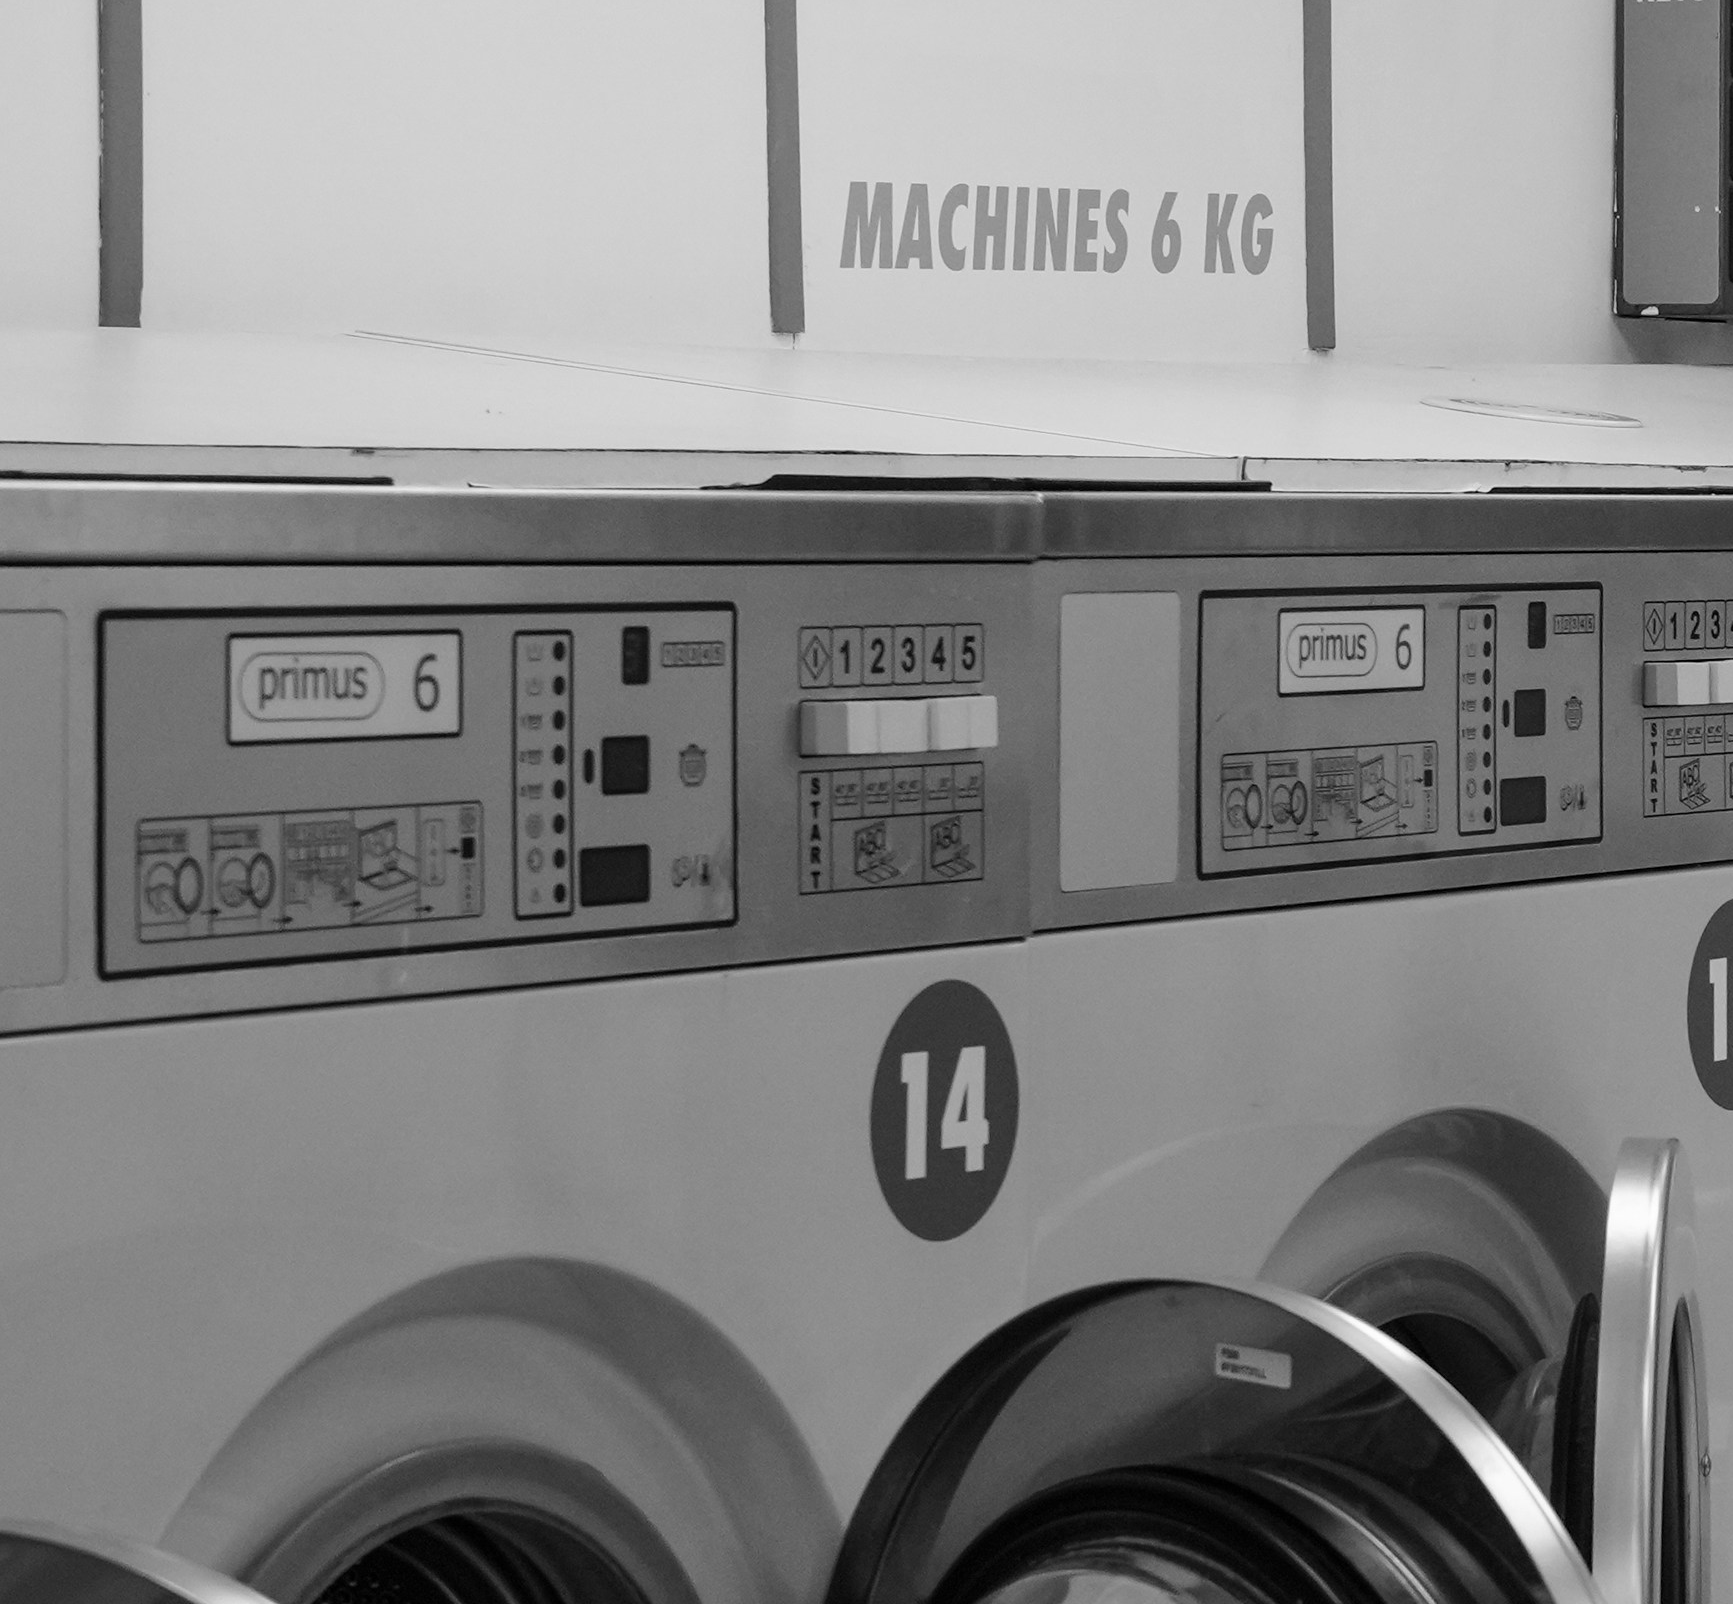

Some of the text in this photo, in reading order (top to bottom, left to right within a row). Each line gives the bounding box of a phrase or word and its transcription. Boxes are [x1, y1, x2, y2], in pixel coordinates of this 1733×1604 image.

[839, 181, 1274, 275] MACHINES 6 KG
[260, 653, 441, 713] primus 6
[1299, 624, 1412, 671] primus 6
[901, 1046, 990, 1180] 14
